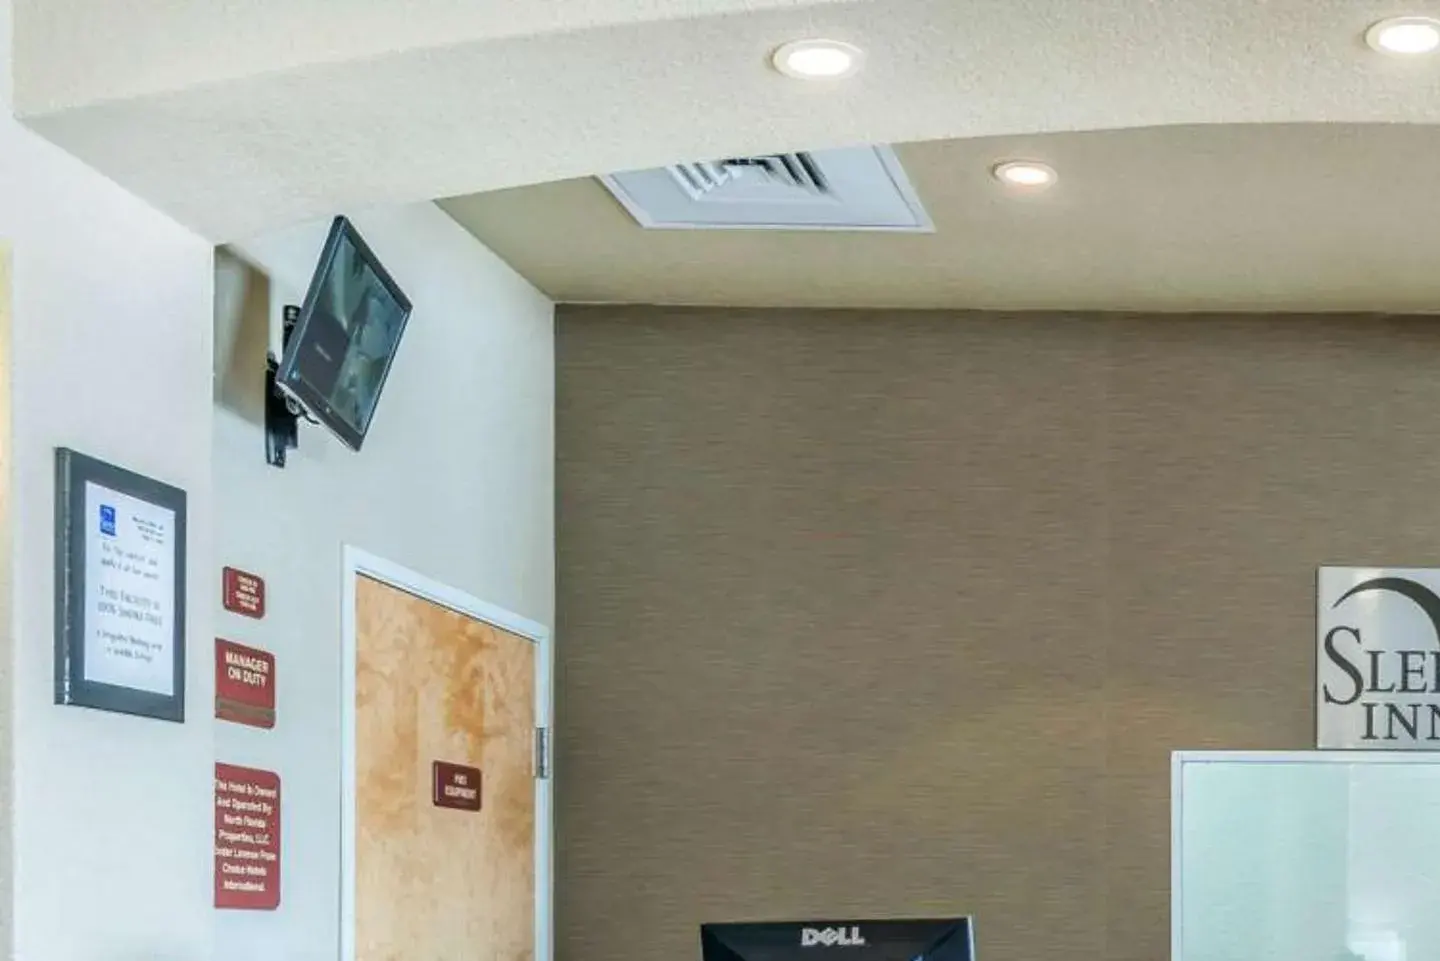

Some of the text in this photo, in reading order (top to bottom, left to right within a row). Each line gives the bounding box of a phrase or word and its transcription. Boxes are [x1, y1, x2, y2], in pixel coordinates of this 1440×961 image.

[225, 651, 269, 674] MANAGER
[227, 666, 267, 687] ON DUTY
[801, 926, 865, 947] DELL
